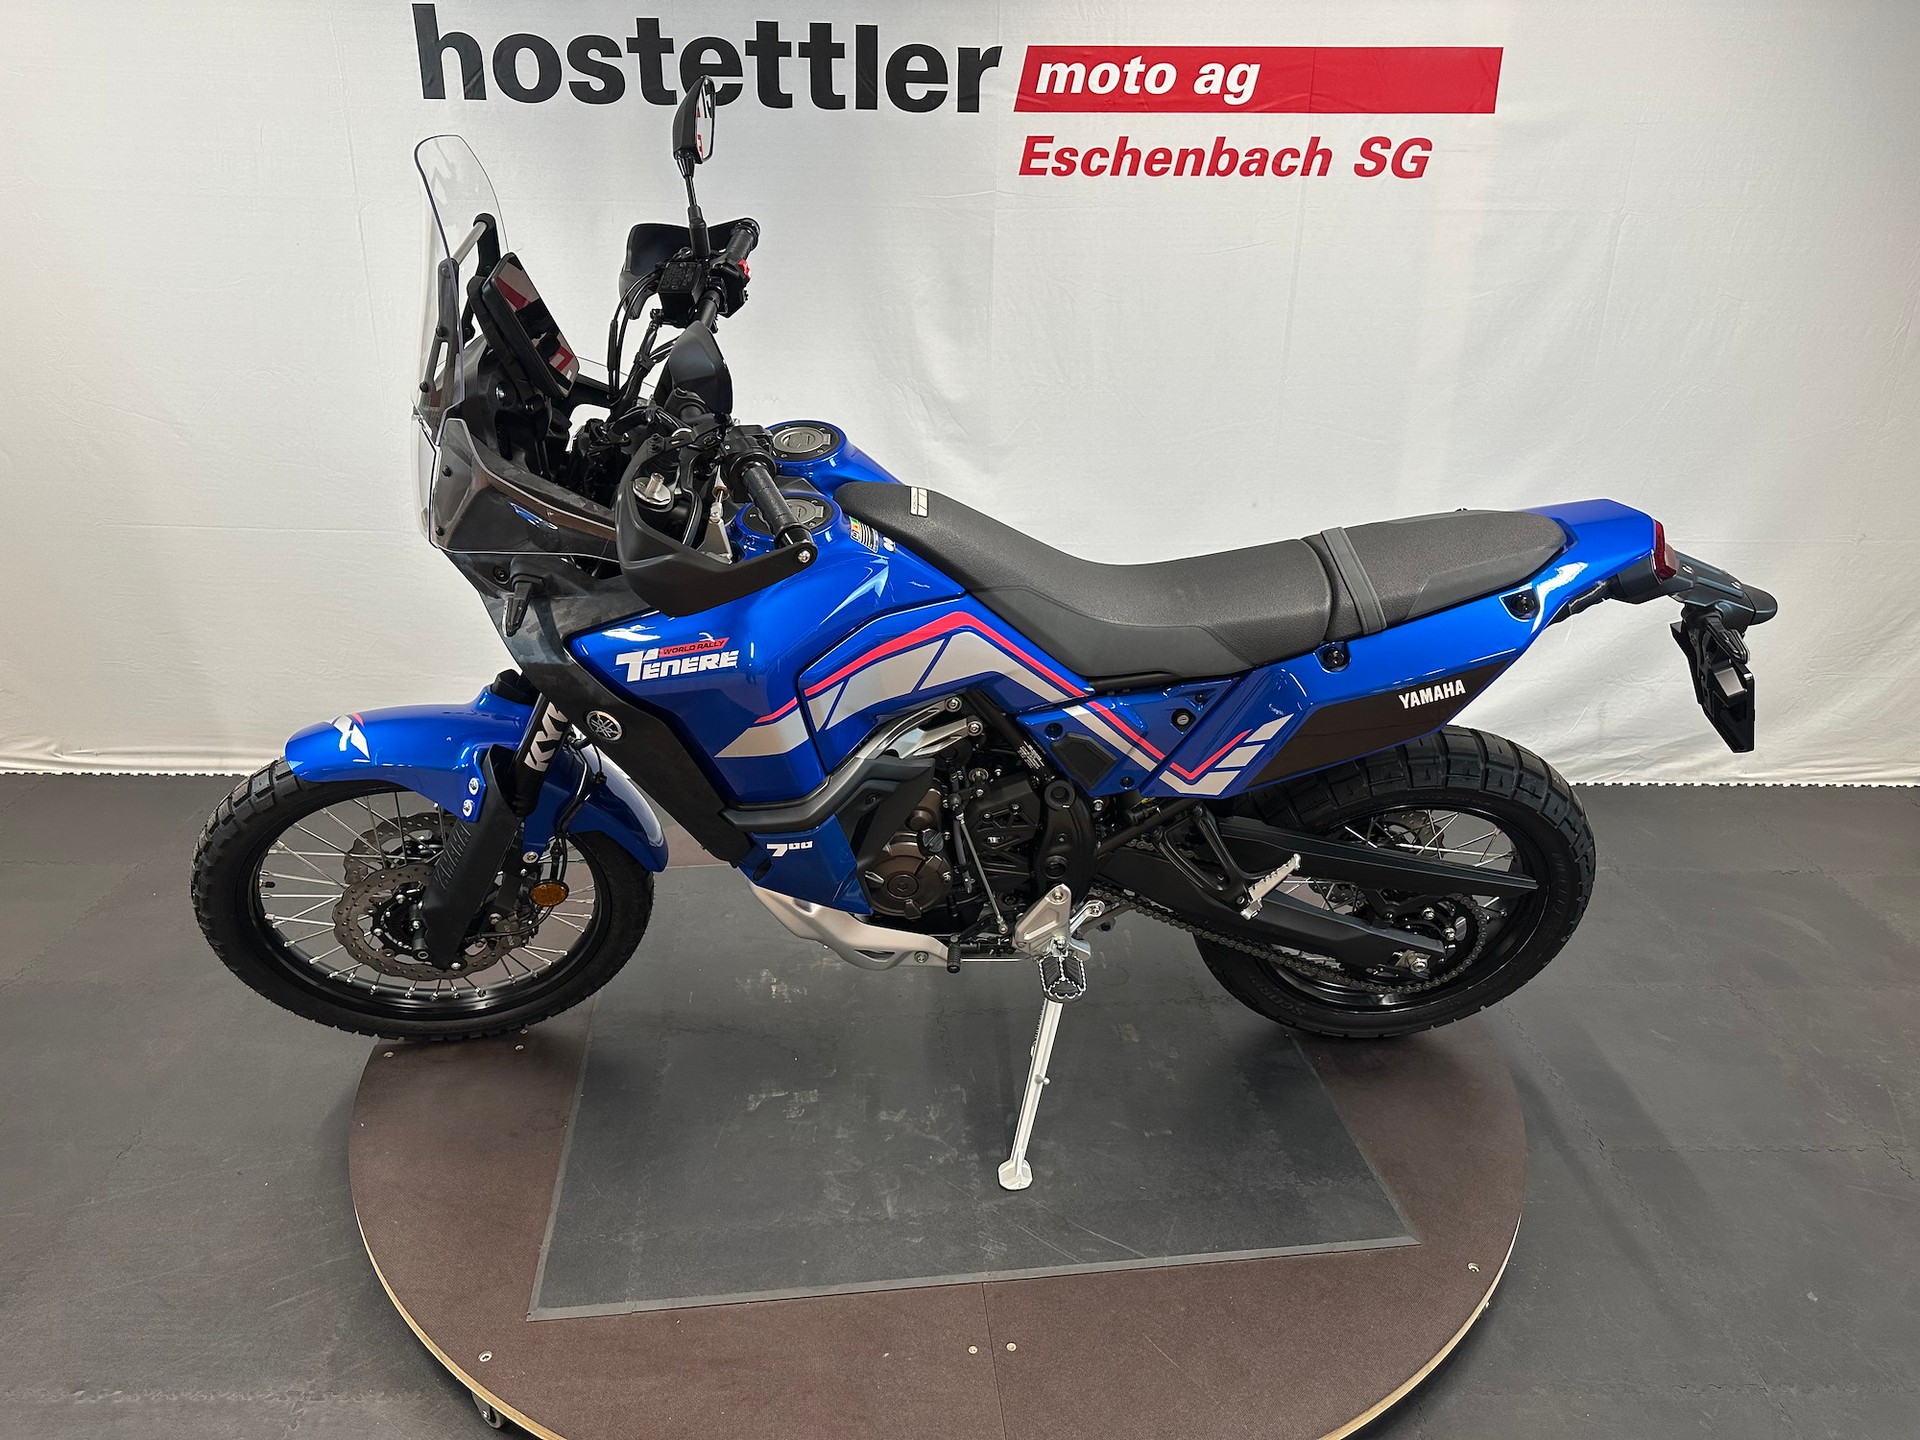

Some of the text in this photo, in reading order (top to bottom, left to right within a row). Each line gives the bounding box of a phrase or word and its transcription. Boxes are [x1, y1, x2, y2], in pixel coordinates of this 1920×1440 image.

[411, 3, 1003, 113] hostettler
[1035, 55, 1261, 105] moto ag
[1018, 135, 1433, 178] Eschenbach SG
[663, 640, 726, 655] WORLD RALLY
[1398, 679, 1467, 709] YAMAHA
[766, 841, 813, 857] 700
